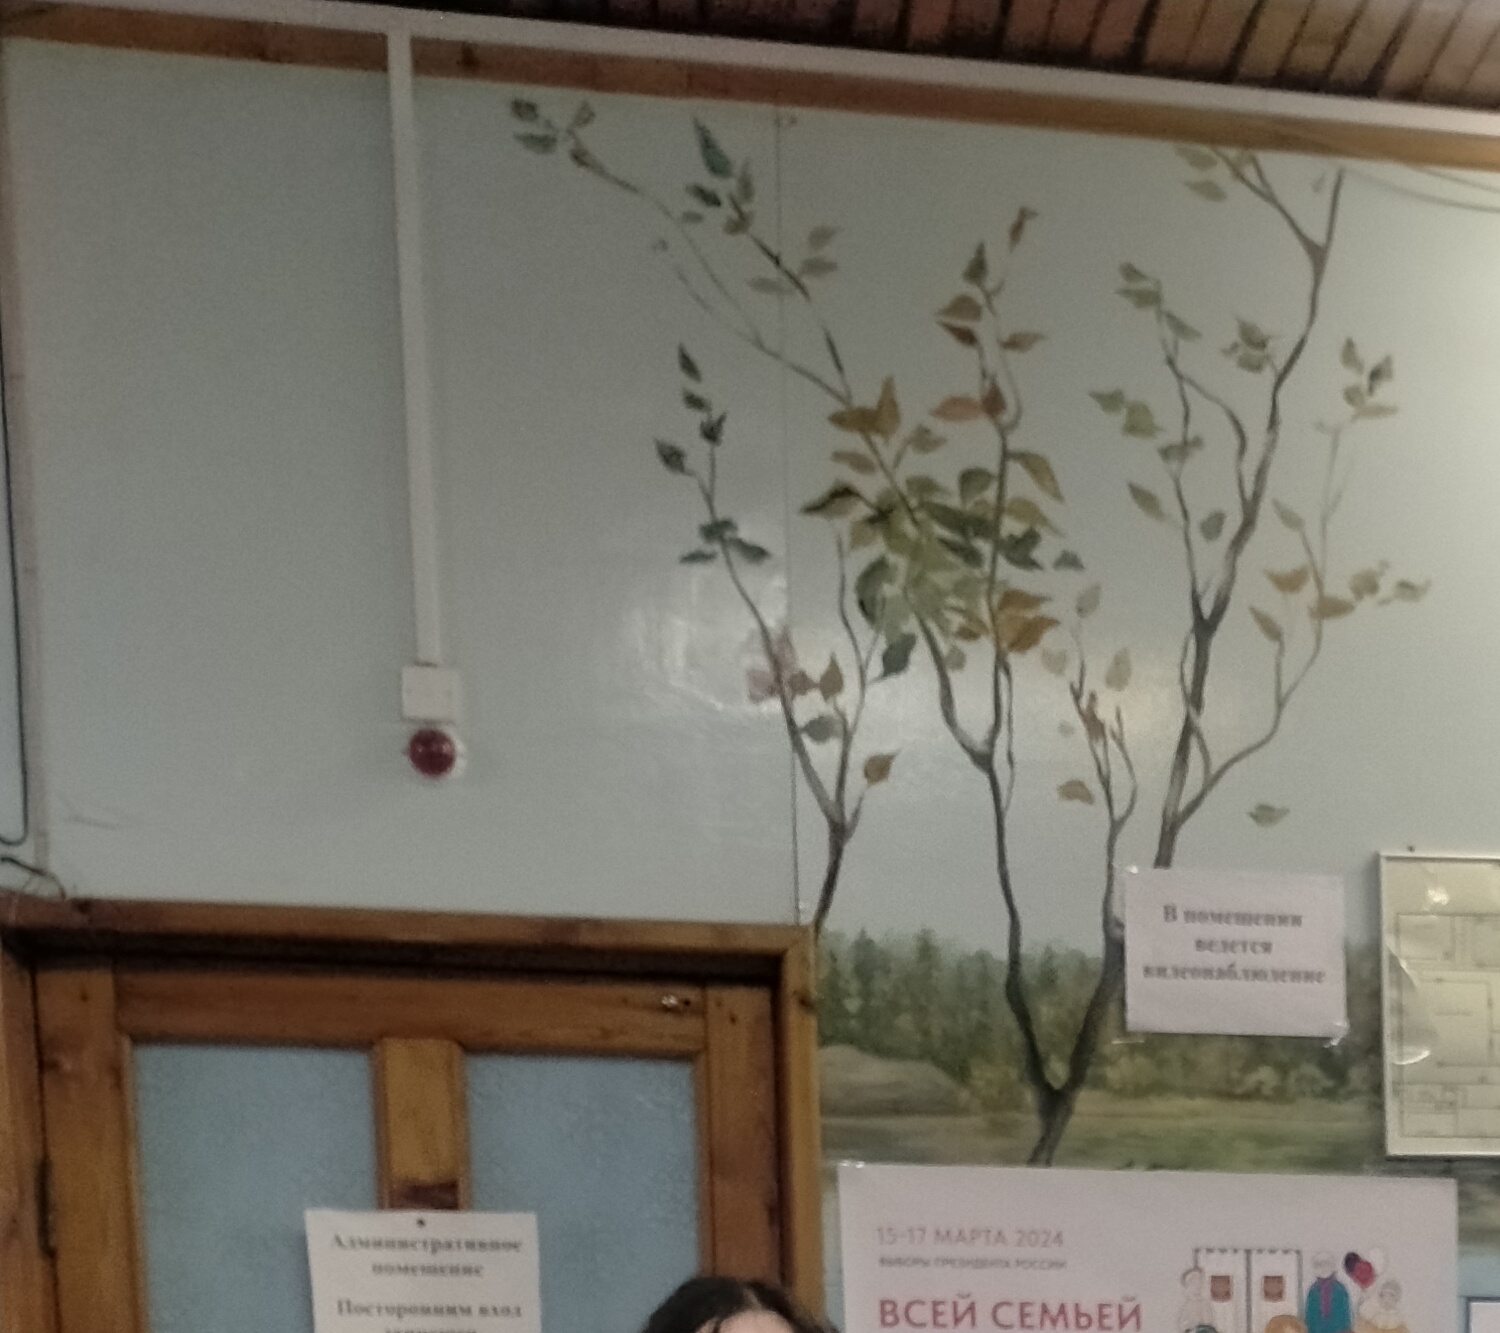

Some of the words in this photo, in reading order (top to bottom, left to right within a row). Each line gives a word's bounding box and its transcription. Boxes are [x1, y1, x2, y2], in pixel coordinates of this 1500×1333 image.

[877, 1227, 926, 1246] 15-17
[934, 1229, 1008, 1246] МАРТА
[1016, 1230, 1064, 1248] 2024
[337, 1299, 473, 1320] Посторонним
[879, 1291, 977, 1330] ВСЕЙ
[991, 1294, 1142, 1333] СЕМЬЕЙ
